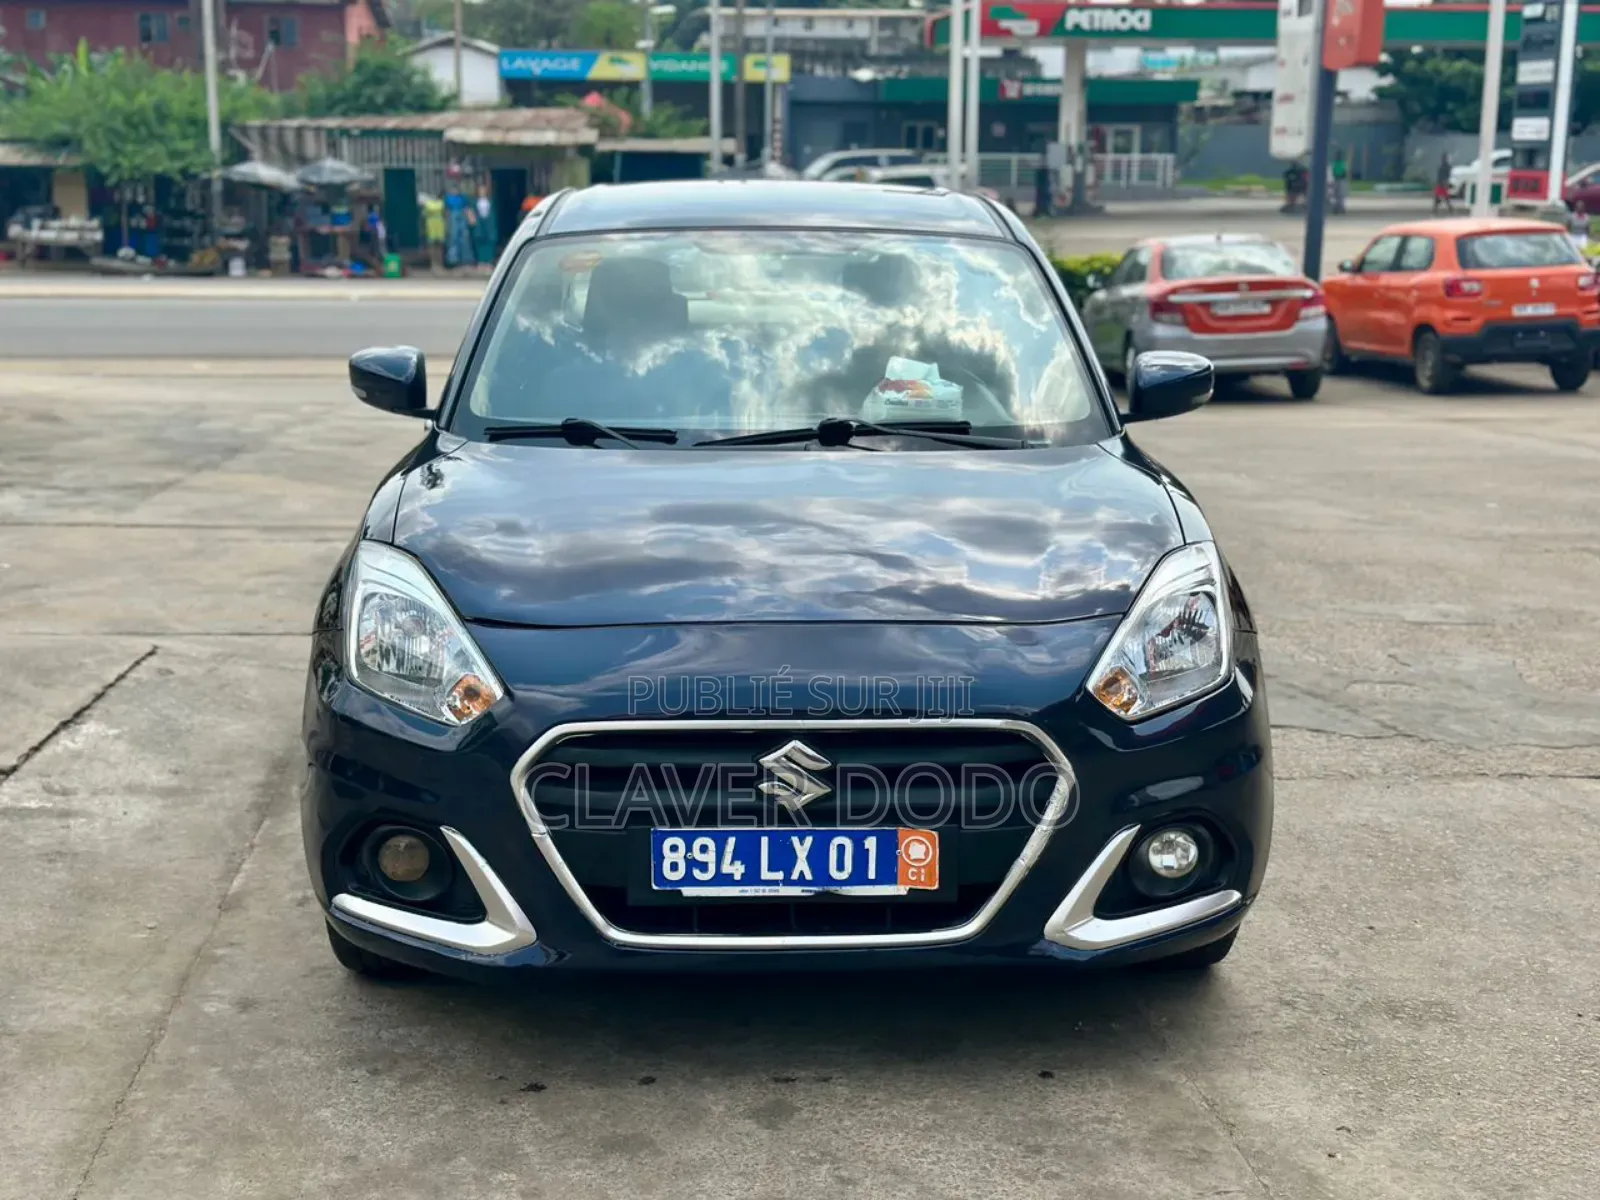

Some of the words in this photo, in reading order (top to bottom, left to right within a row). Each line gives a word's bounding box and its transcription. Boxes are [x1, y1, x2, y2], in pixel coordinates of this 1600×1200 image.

[1065, 9, 1152, 31] PETROCI
[501, 57, 581, 71] LAVAGE
[661, 836, 746, 881] 894
[760, 835, 814, 880] LX
[828, 835, 877, 880] 01
